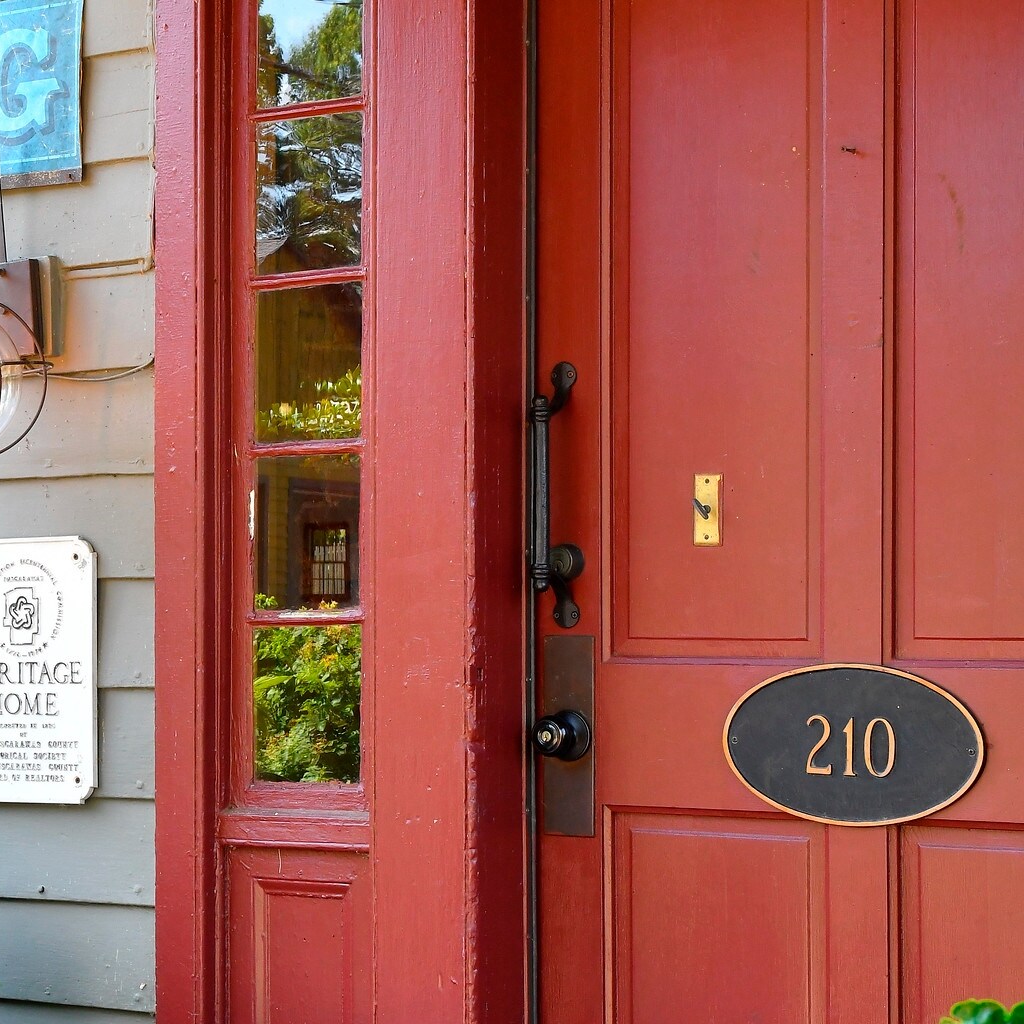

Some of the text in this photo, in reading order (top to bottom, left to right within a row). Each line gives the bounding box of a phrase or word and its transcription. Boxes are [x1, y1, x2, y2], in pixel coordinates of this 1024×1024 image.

[19, 558, 59, 586] BICENTENNIAL
[50, 590, 64, 640] COMMISSION
[47, 740, 79, 749] COUNTY
[805, 713, 897, 778] 210
[33, 752, 67, 761] SOCIETY
[48, 763, 79, 772] COUNTY
[11, 773, 21, 782] OF
[25, 774, 65, 783] REALTORS
